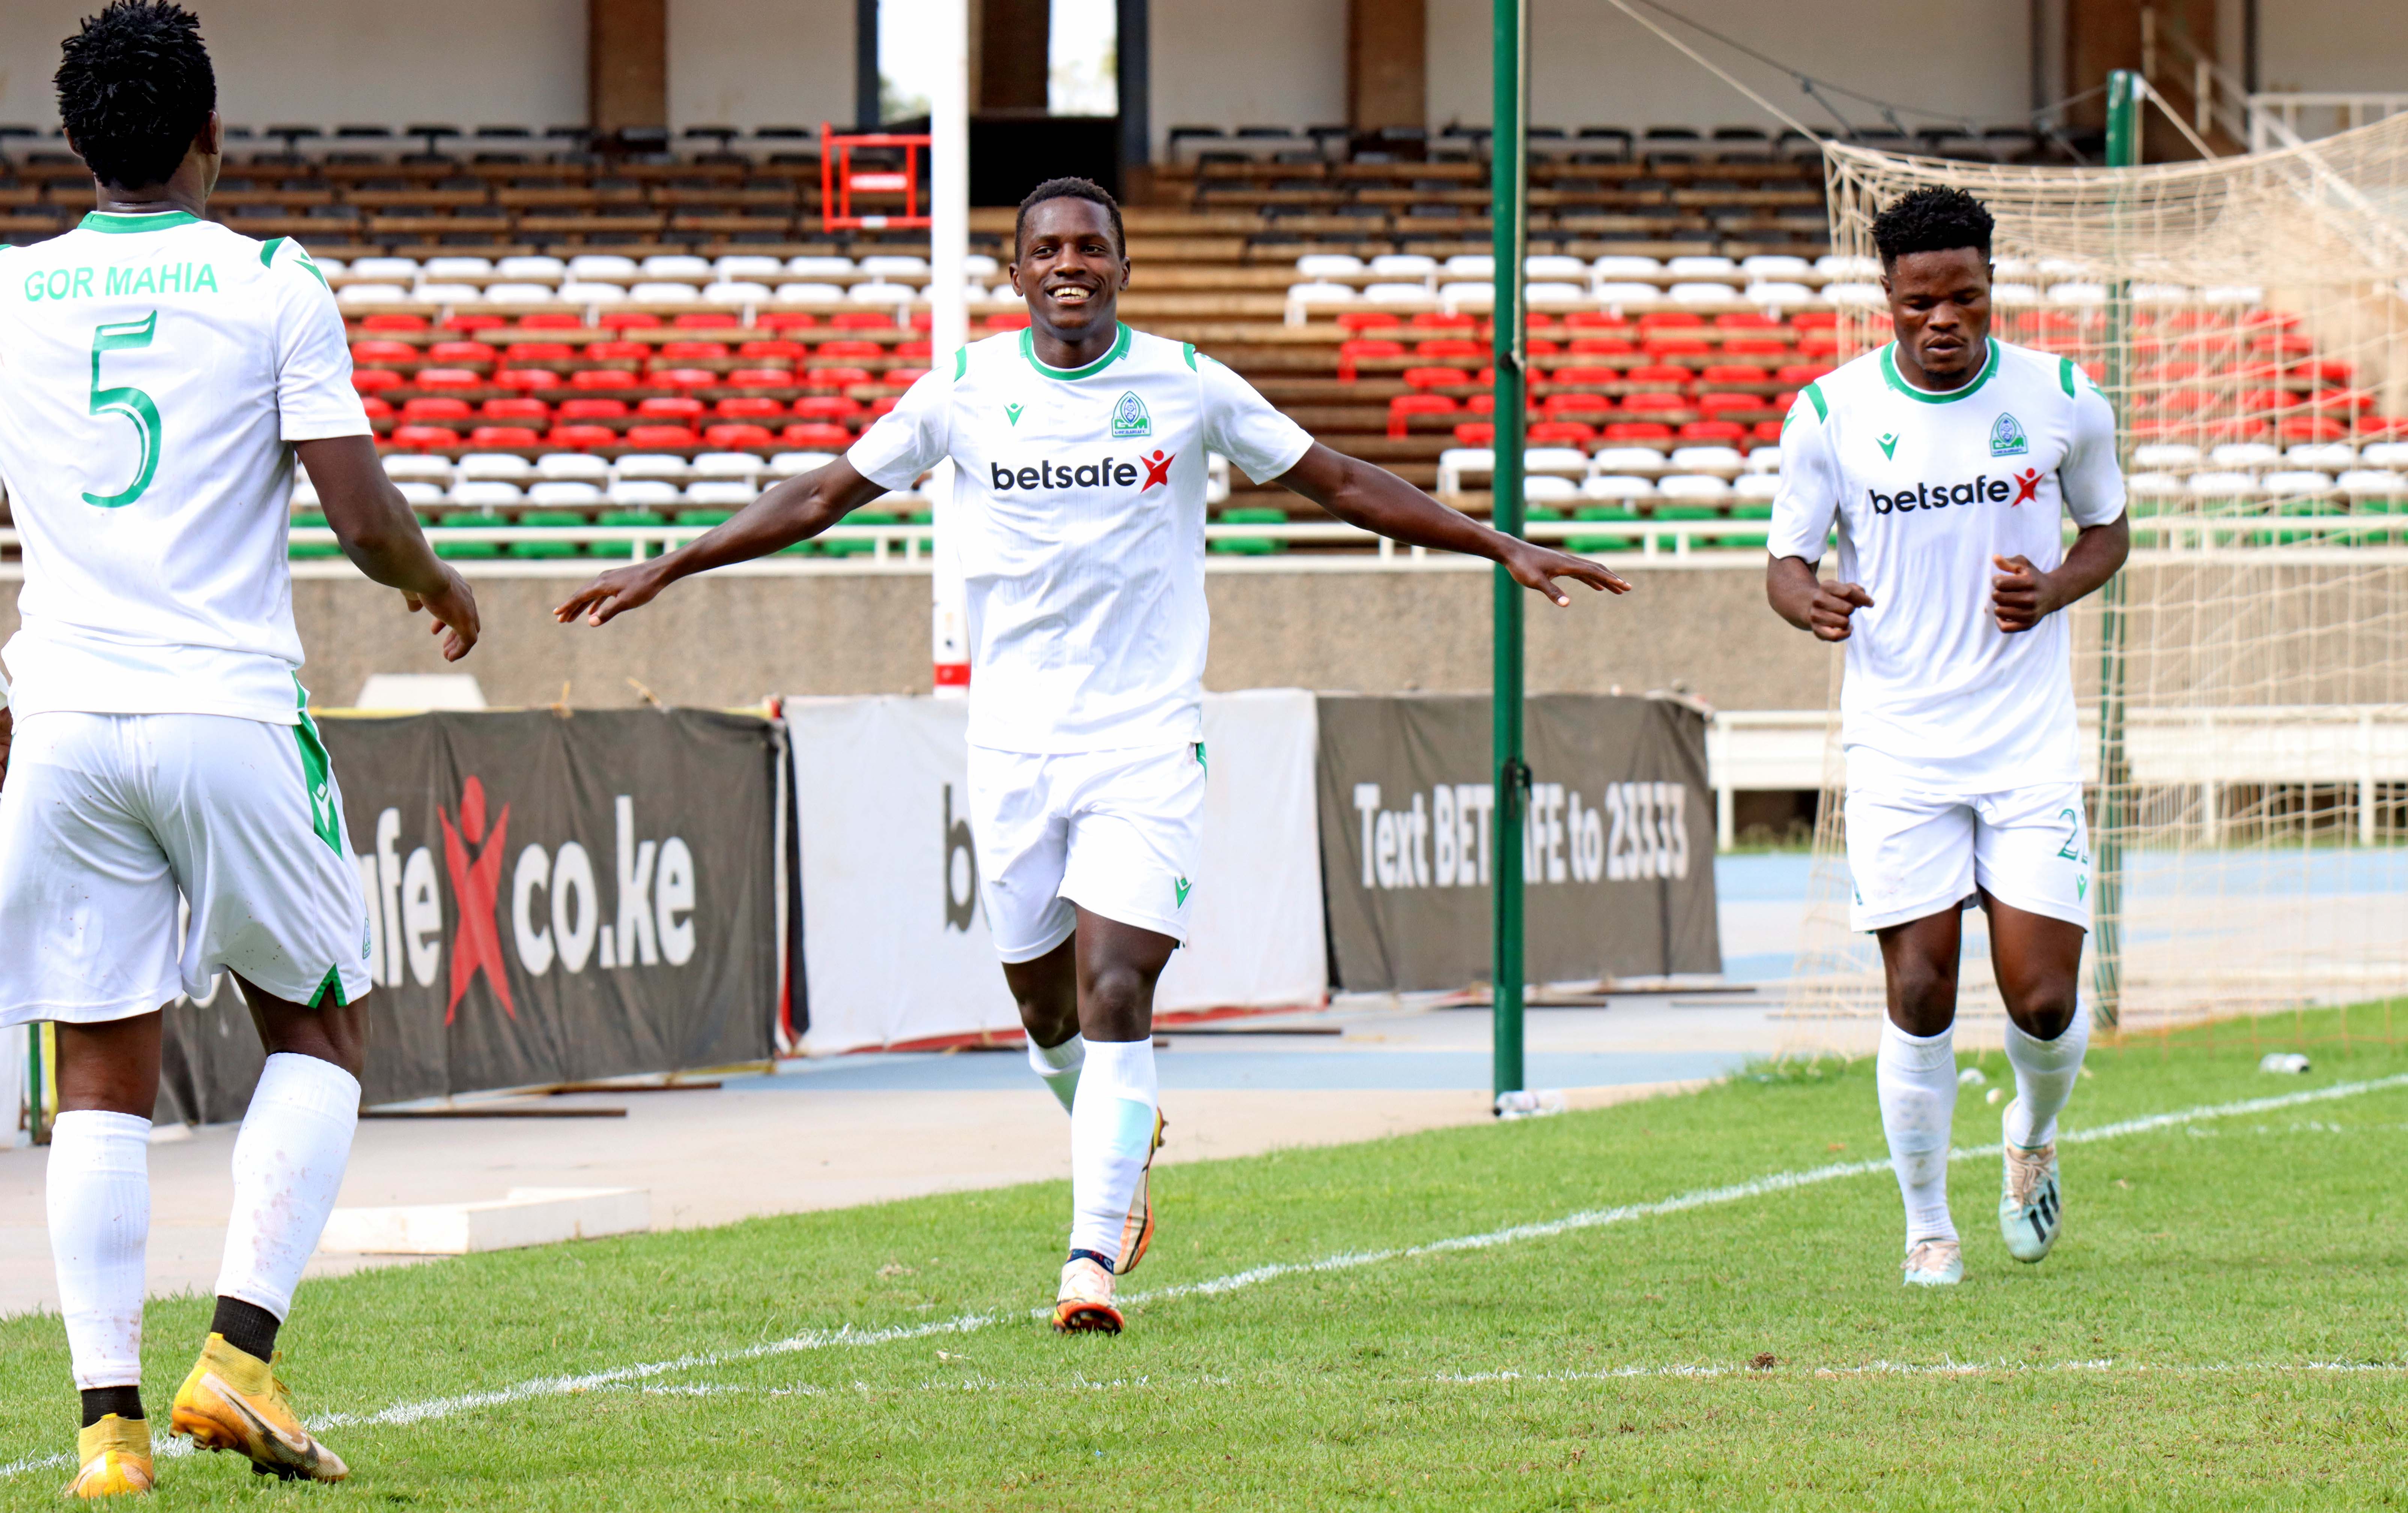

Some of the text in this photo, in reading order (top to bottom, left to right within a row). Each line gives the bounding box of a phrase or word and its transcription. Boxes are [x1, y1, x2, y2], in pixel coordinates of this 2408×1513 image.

[24, 262, 218, 302] GOR MAHIA
[81, 310, 161, 508] 5
[991, 457, 1138, 490] betsafe
[1869, 475, 2010, 514] betsafe
[1354, 783, 1430, 889] Text
[1433, 782, 1567, 887] BETFE
[1568, 791, 1603, 883] to
[512, 795, 695, 976] co.ke
